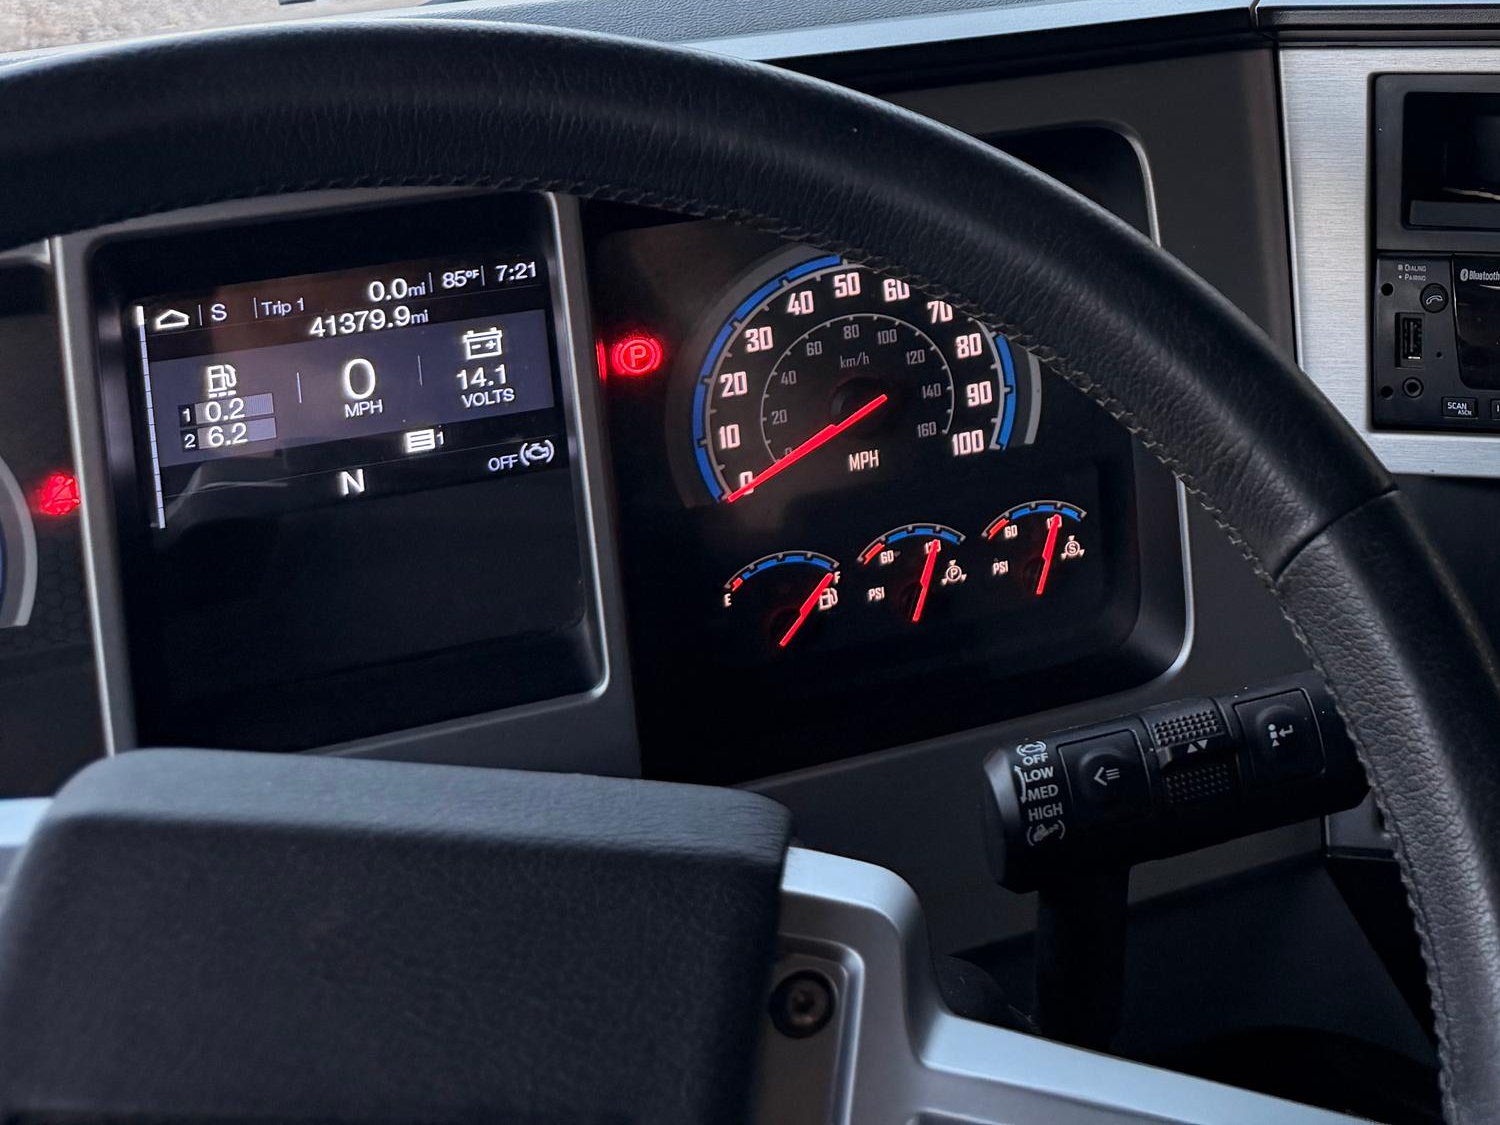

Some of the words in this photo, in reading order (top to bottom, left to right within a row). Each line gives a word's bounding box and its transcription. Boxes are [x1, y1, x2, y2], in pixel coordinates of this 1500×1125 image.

[495, 261, 537, 283] 7:21
[833, 272, 862, 299] 50
[883, 278, 911, 303] 60
[210, 303, 228, 322] S
[260, 300, 292, 317] Trip
[296, 297, 305, 312] 1
[786, 290, 815, 317] 40
[926, 300, 954, 325] 70
[744, 326, 774, 353] 30
[843, 324, 860, 340] 80
[876, 328, 899, 346] 100
[806, 341, 823, 357] 60
[955, 332, 983, 360] 80
[839, 353, 870, 370] km/h
[905, 348, 926, 366] 120
[342, 357, 377, 401] 0
[456, 363, 508, 391] 14.1
[719, 370, 748, 399] 20
[780, 370, 798, 386] 40
[461, 387, 516, 409] VOLTS
[921, 382, 942, 400] 140
[966, 381, 993, 408] 90
[182, 408, 191, 423] 1
[205, 397, 246, 423] 0.2
[344, 398, 384, 419] MPH
[1447, 401, 1468, 410] SCAN
[771, 408, 788, 425] 20
[184, 433, 196, 449] 2
[208, 422, 249, 448] 6.2
[719, 423, 741, 451] 10
[916, 421, 938, 438] 160
[951, 429, 985, 457] 100
[487, 453, 519, 473] OFF
[848, 449, 880, 472] MPH
[342, 468, 366, 496] N
[1004, 524, 1018, 539] 60
[879, 549, 895, 565] 60
[833, 570, 842, 585] F
[992, 560, 1009, 576] PSI
[724, 592, 732, 608] E
[867, 586, 886, 603] PSI
[1022, 752, 1048, 766] OFF
[1024, 766, 1054, 784] LOW
[1028, 784, 1059, 801] MED
[1027, 803, 1064, 822] HIGH
